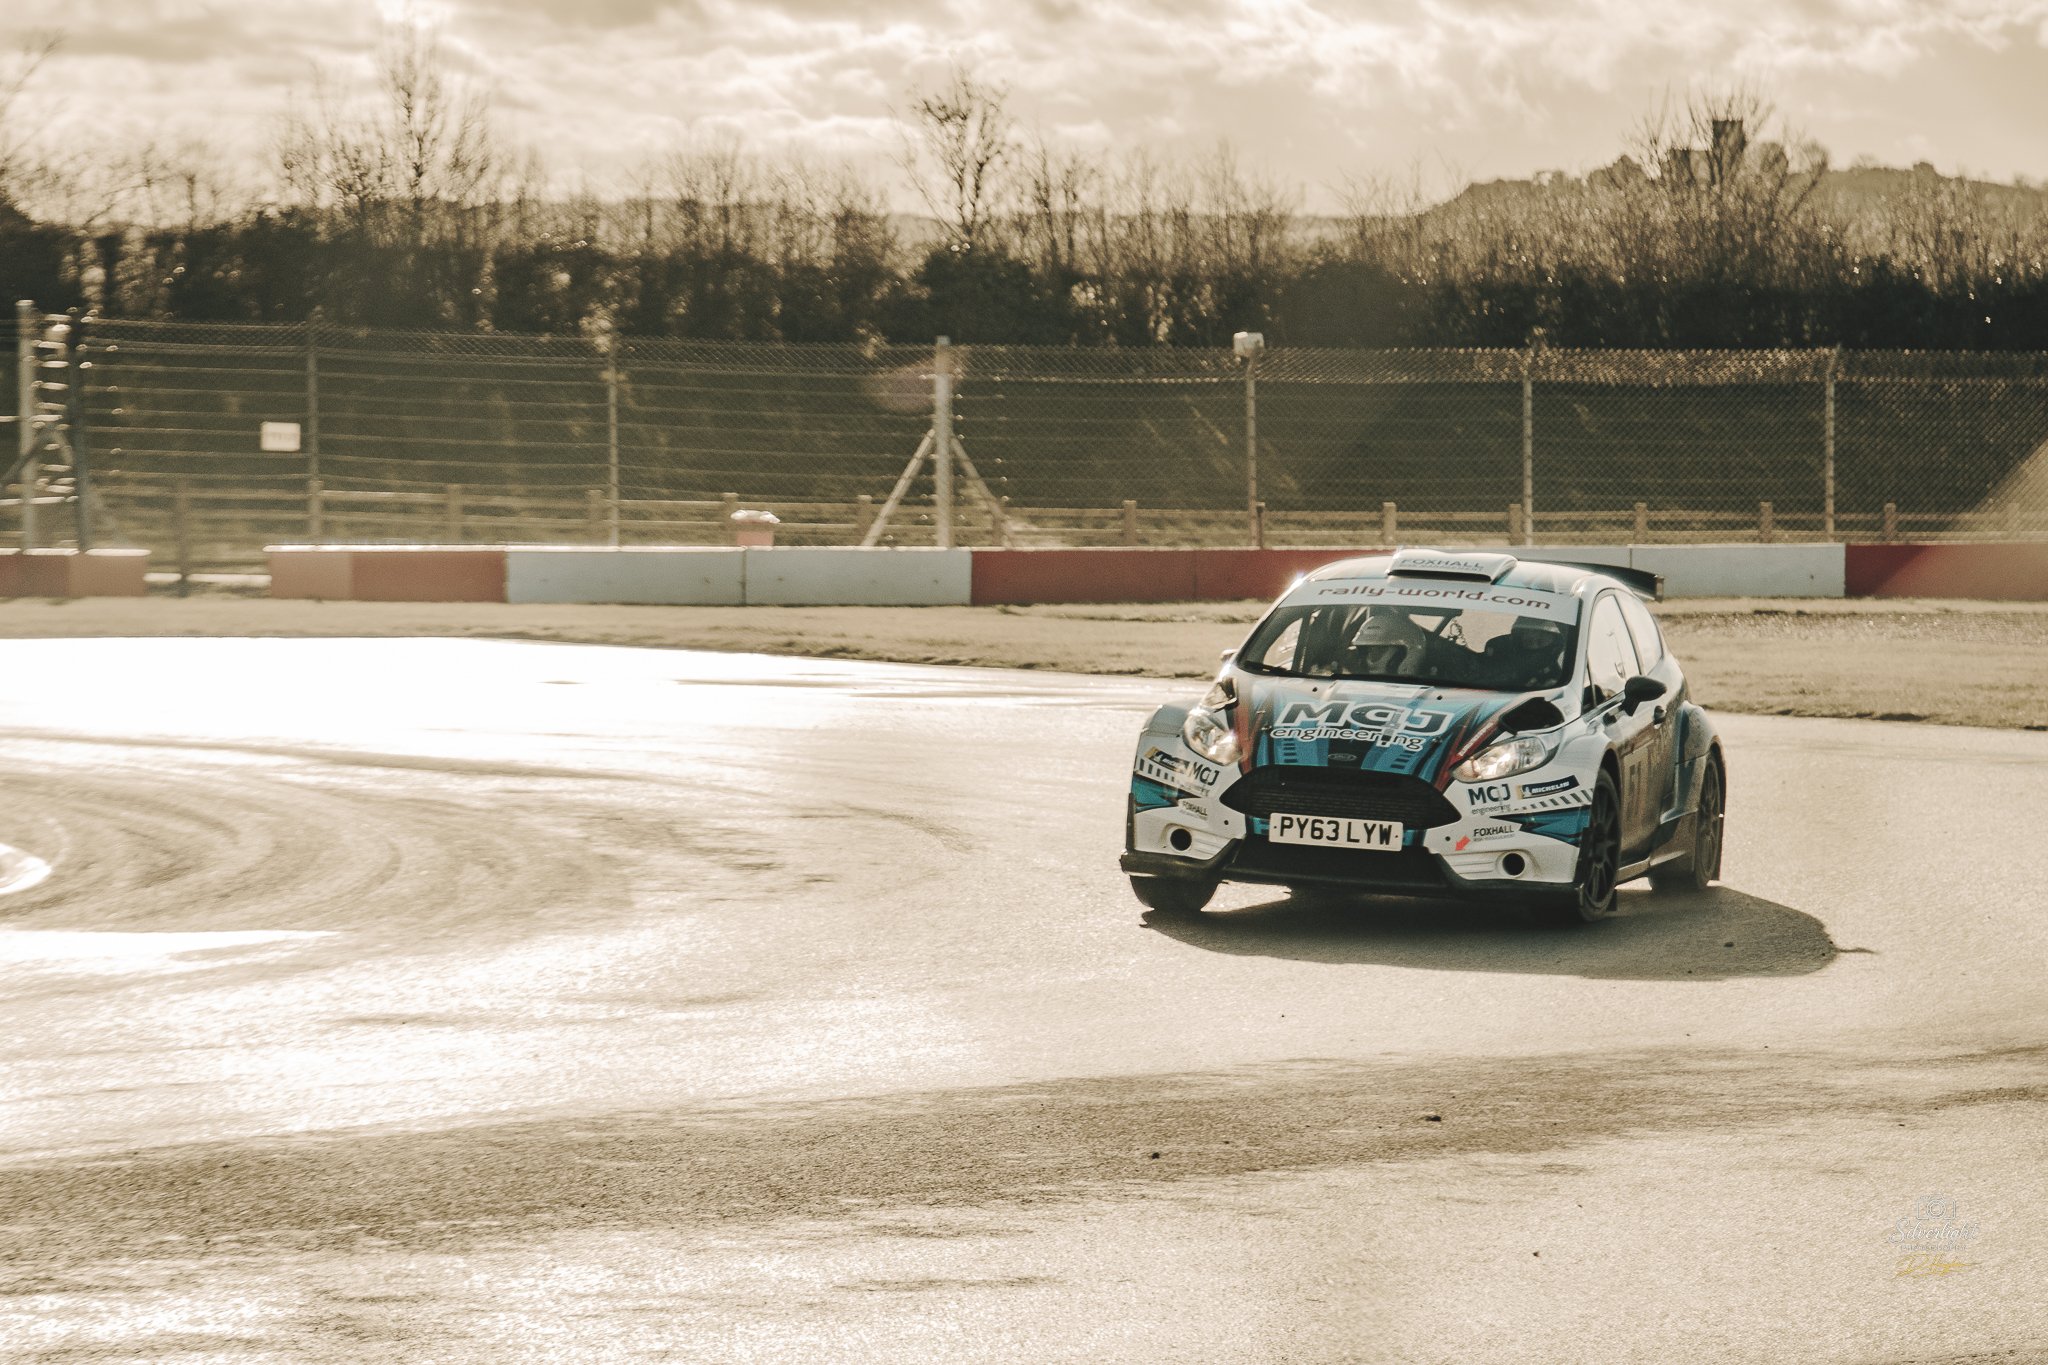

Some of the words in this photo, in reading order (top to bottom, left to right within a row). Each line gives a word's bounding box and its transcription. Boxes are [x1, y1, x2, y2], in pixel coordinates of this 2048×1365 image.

[1402, 558, 1485, 569] FOXHALL
[1318, 586, 1551, 610] rally-world.com
[1280, 816, 1339, 841] PY63
[1347, 821, 1393, 846] LYW
[1474, 824, 1515, 837] FOXHALL
